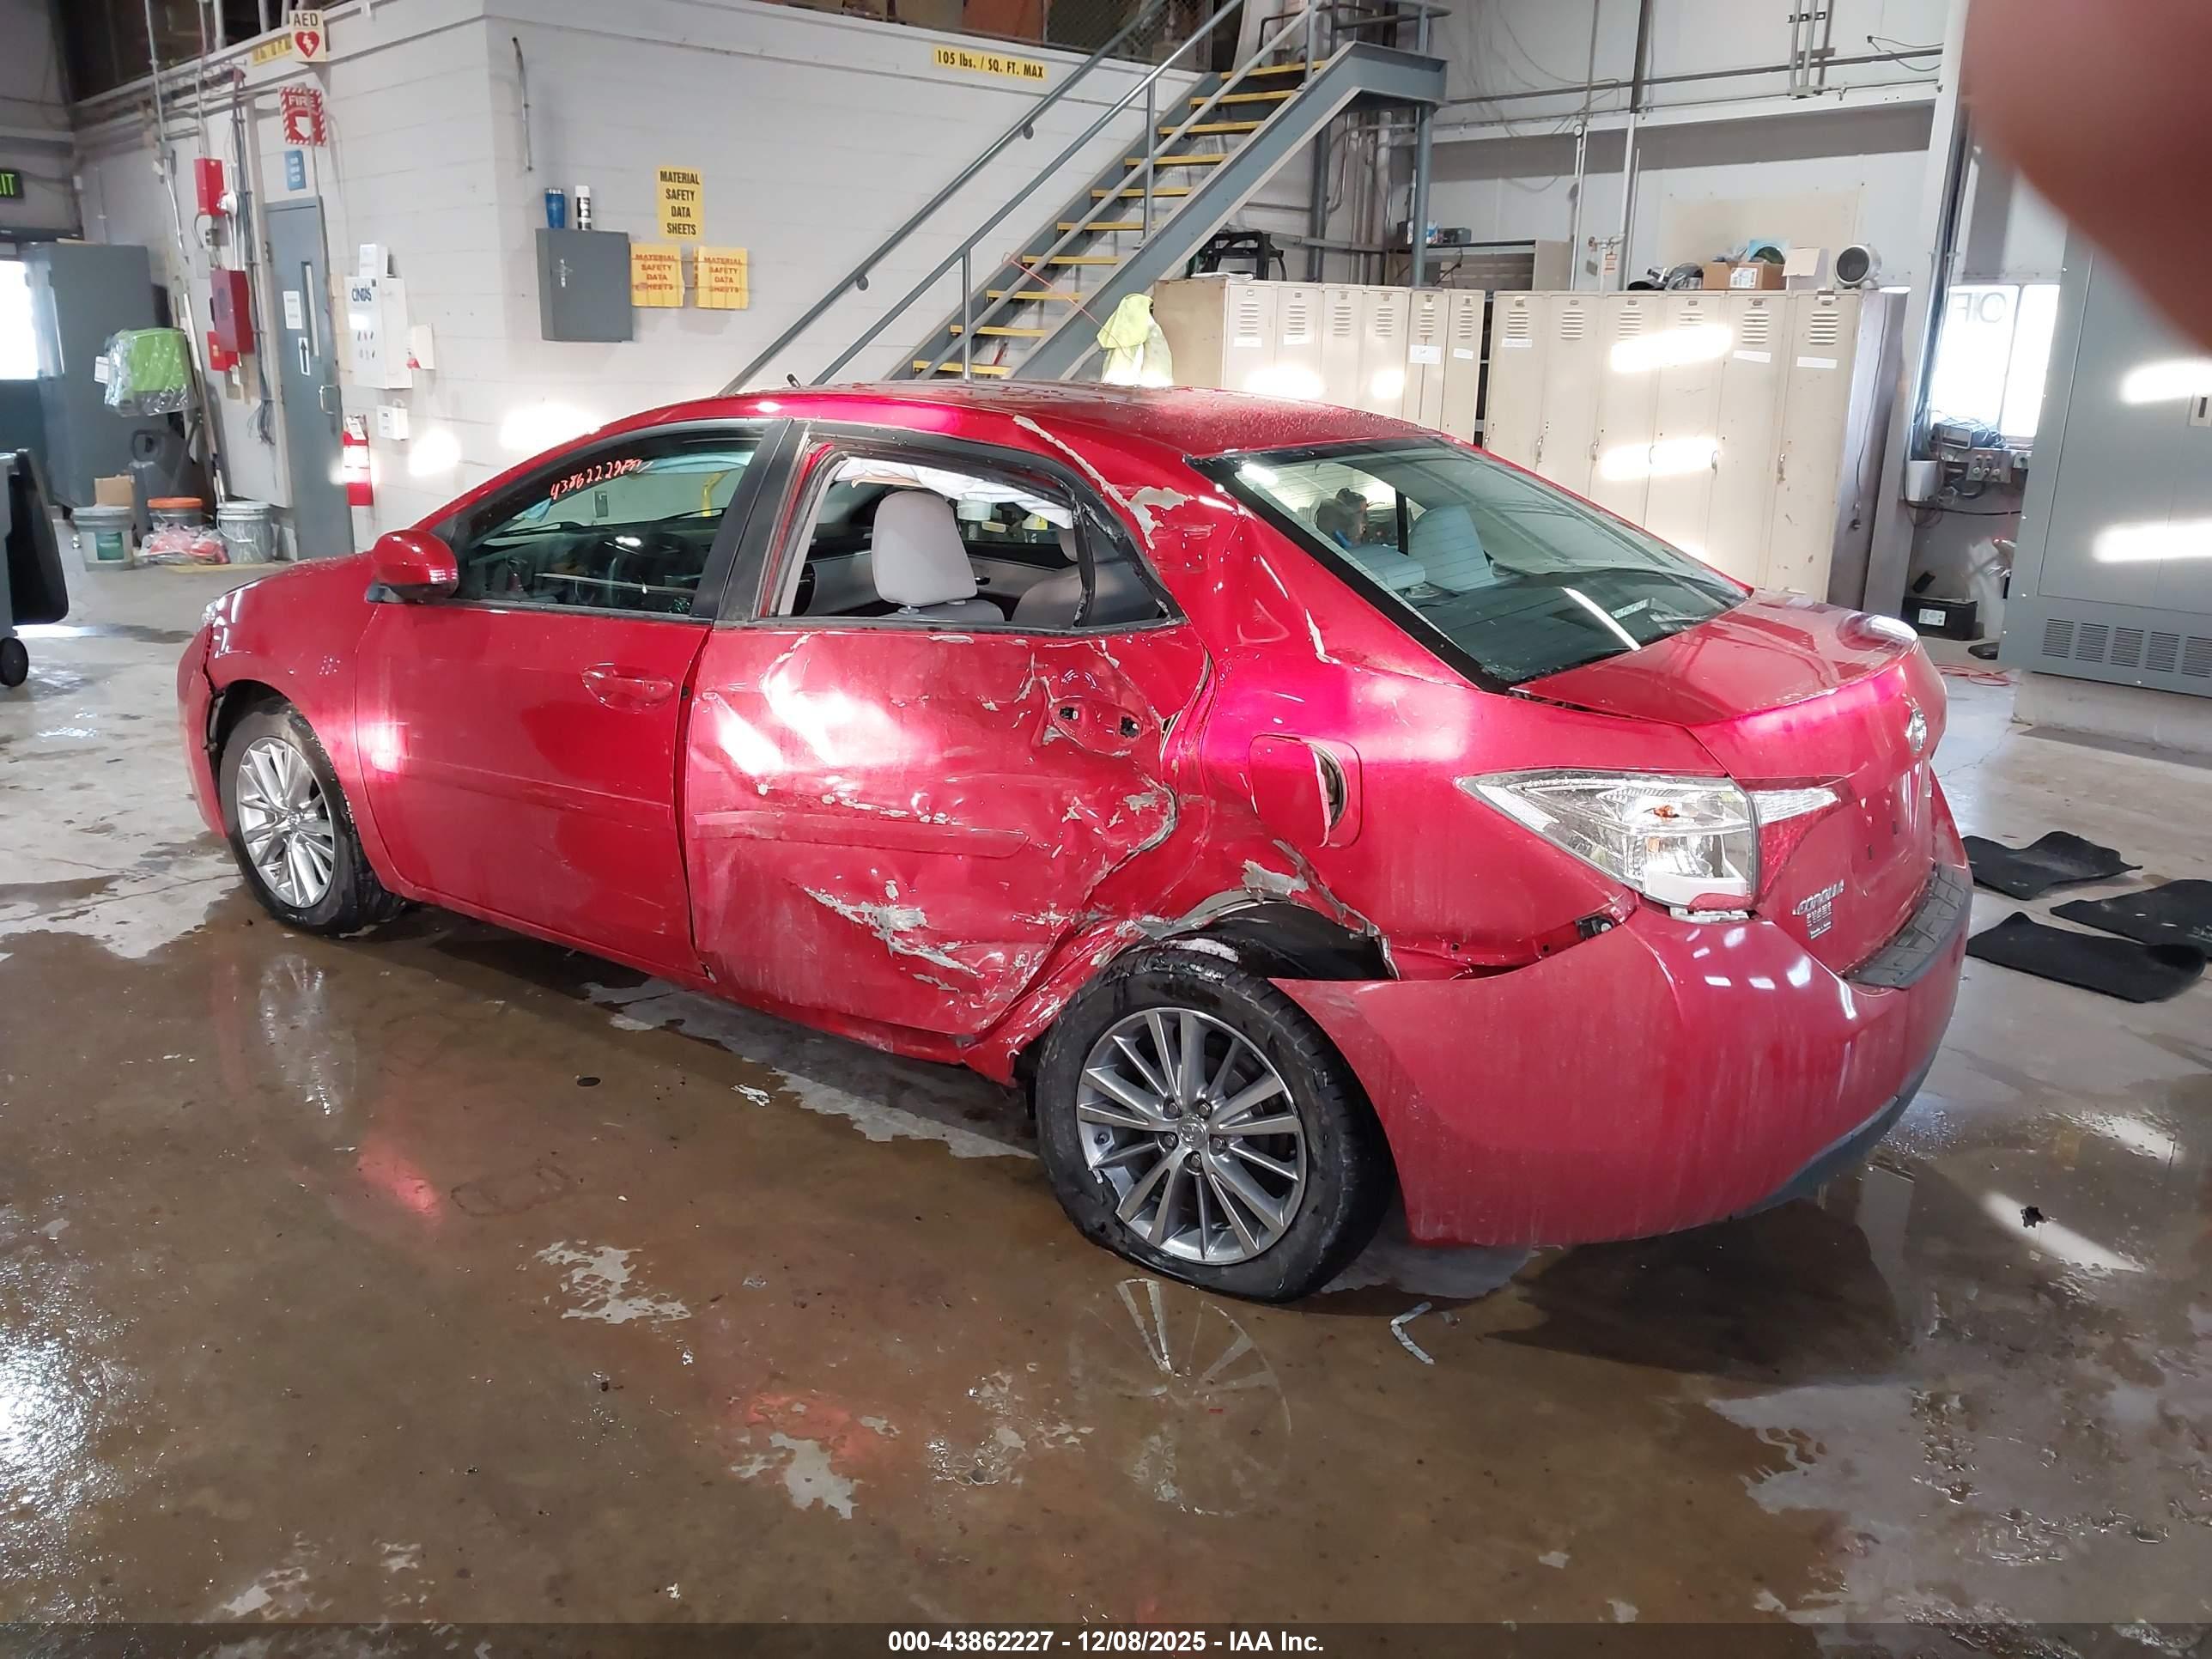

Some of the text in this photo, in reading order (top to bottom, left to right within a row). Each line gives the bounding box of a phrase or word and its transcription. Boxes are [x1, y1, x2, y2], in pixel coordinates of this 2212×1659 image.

[293, 13, 319, 27] AED
[938, 50, 1044, 78] 105 lbs. / SQ. FT. MAX
[659, 171, 700, 185] MATERIAL
[665, 188, 696, 201] SAFETY
[671, 205, 691, 218] DATA
[666, 222, 696, 236] SHEETS
